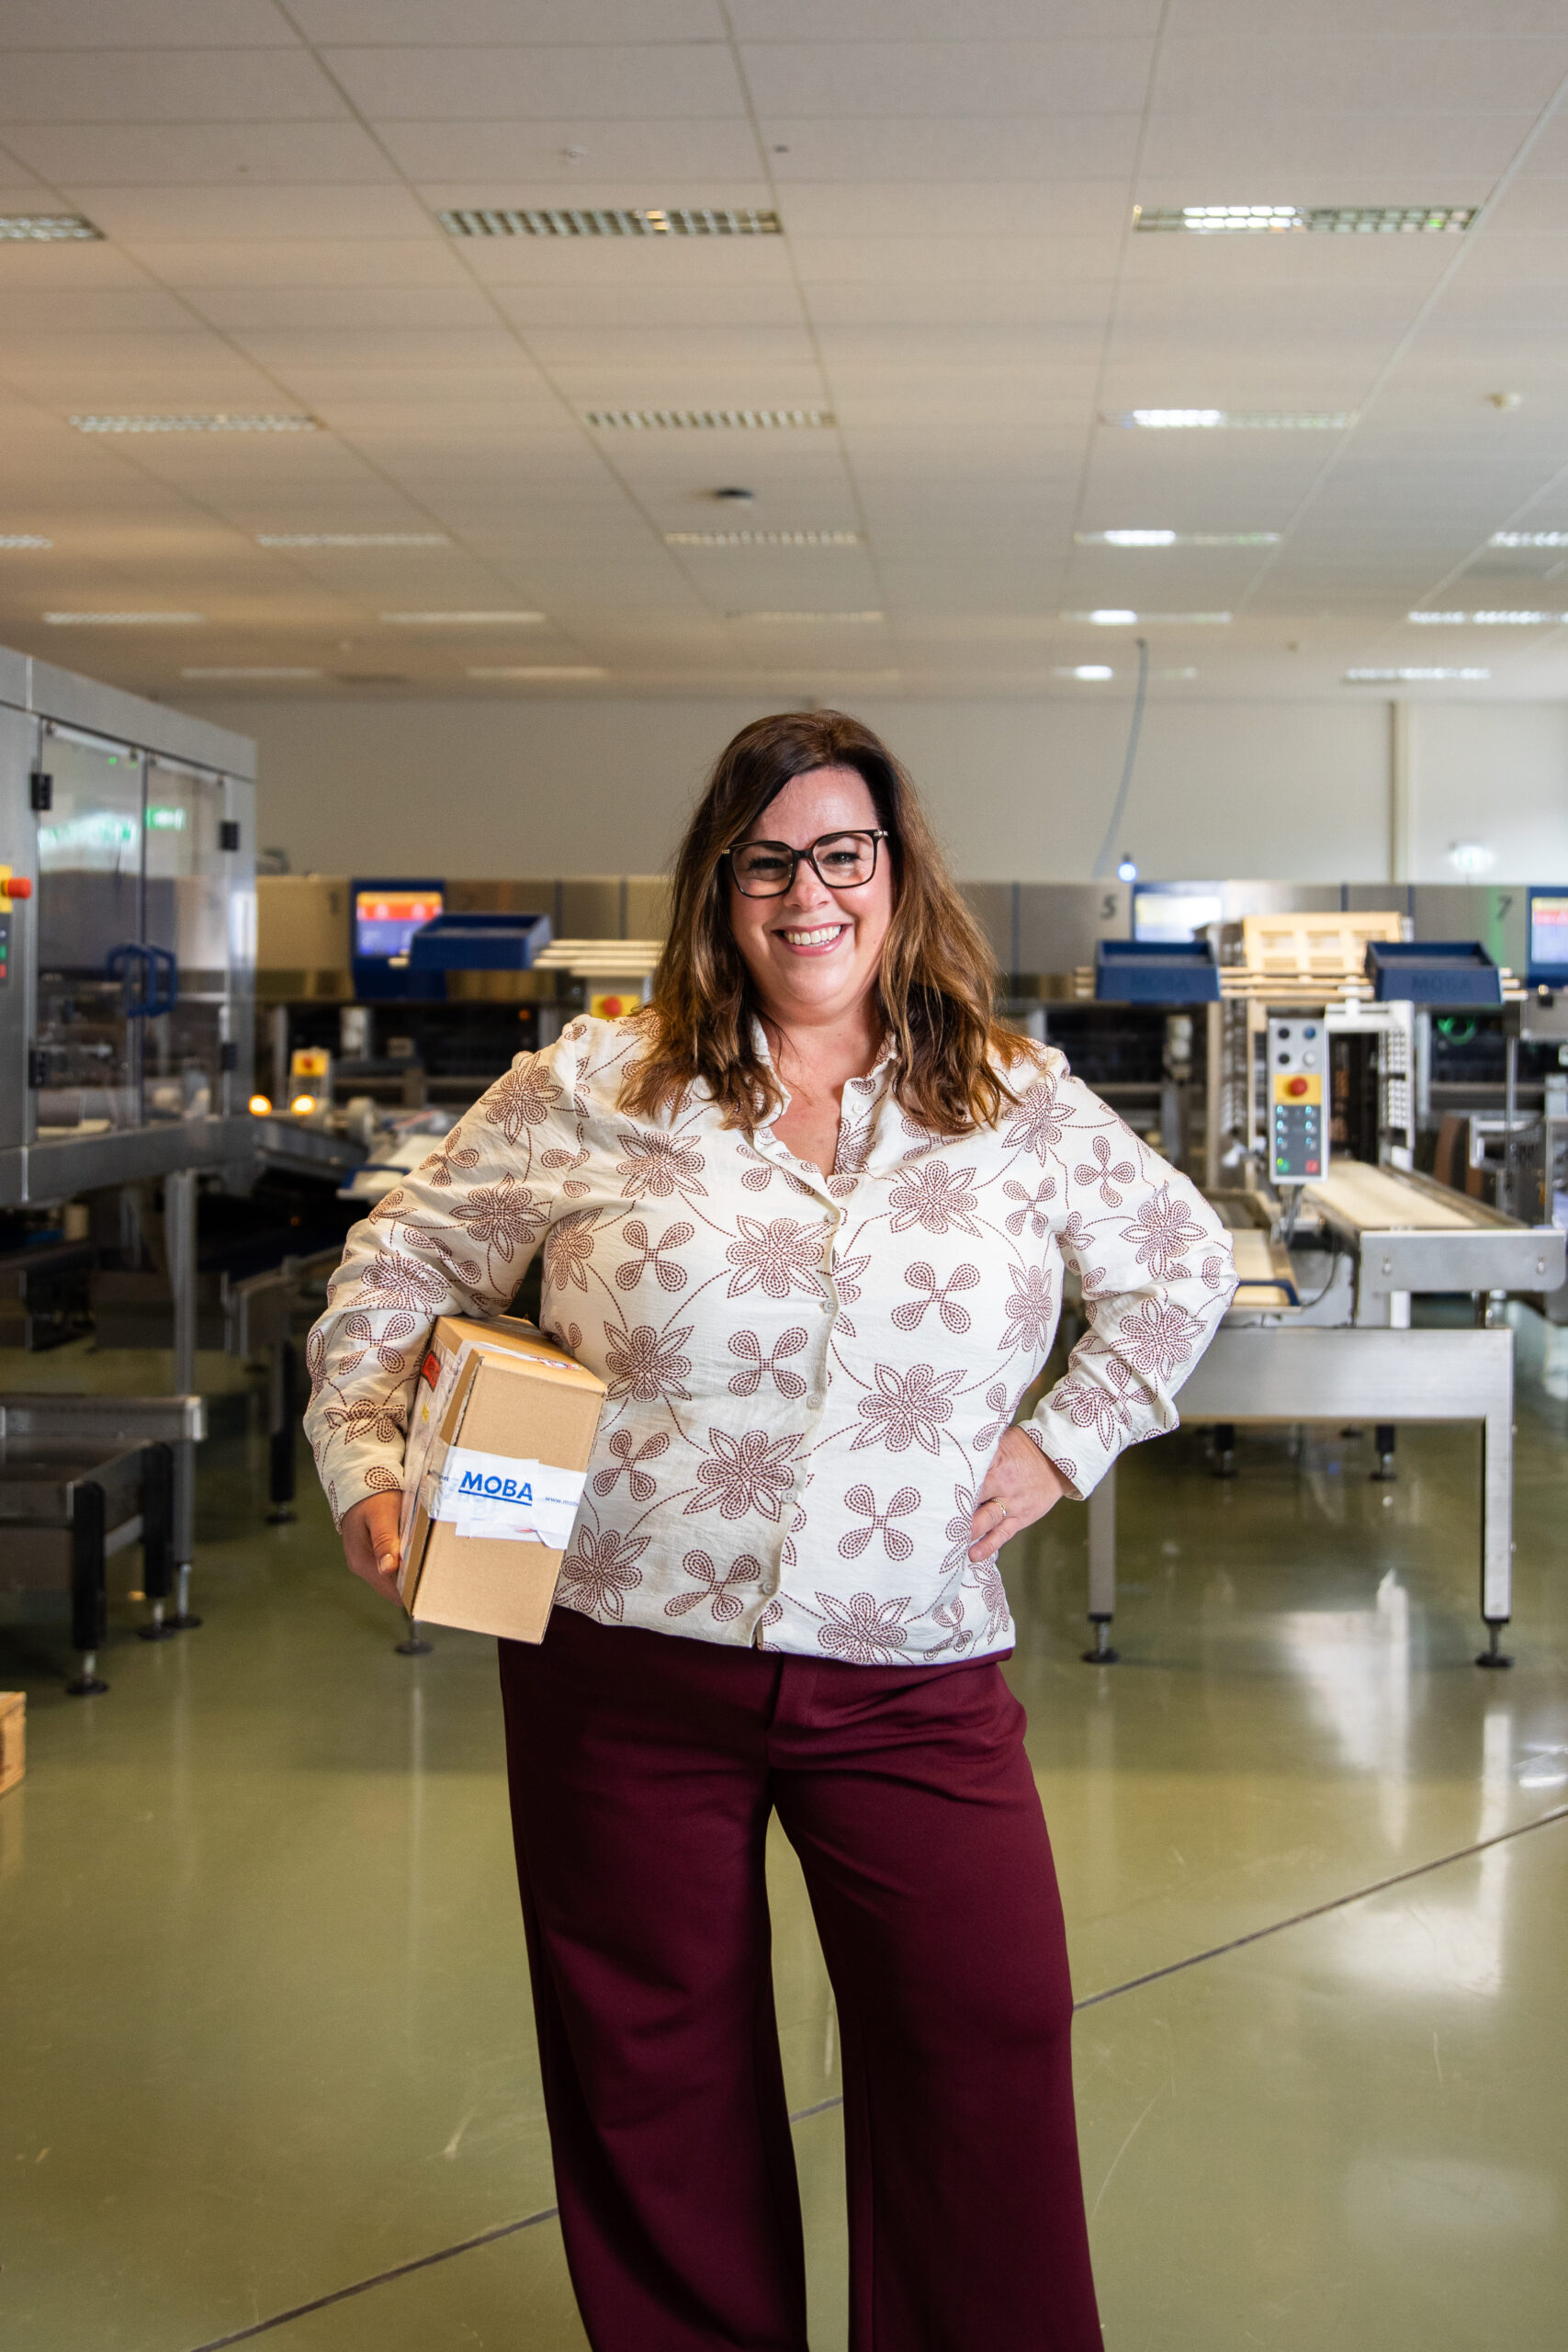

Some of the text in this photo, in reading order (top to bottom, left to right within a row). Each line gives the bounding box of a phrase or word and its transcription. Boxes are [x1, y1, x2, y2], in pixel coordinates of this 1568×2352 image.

[1100, 894, 1117, 920] 5
[1496, 895, 1513, 921] 7
[459, 1470, 533, 1501] MOBA
